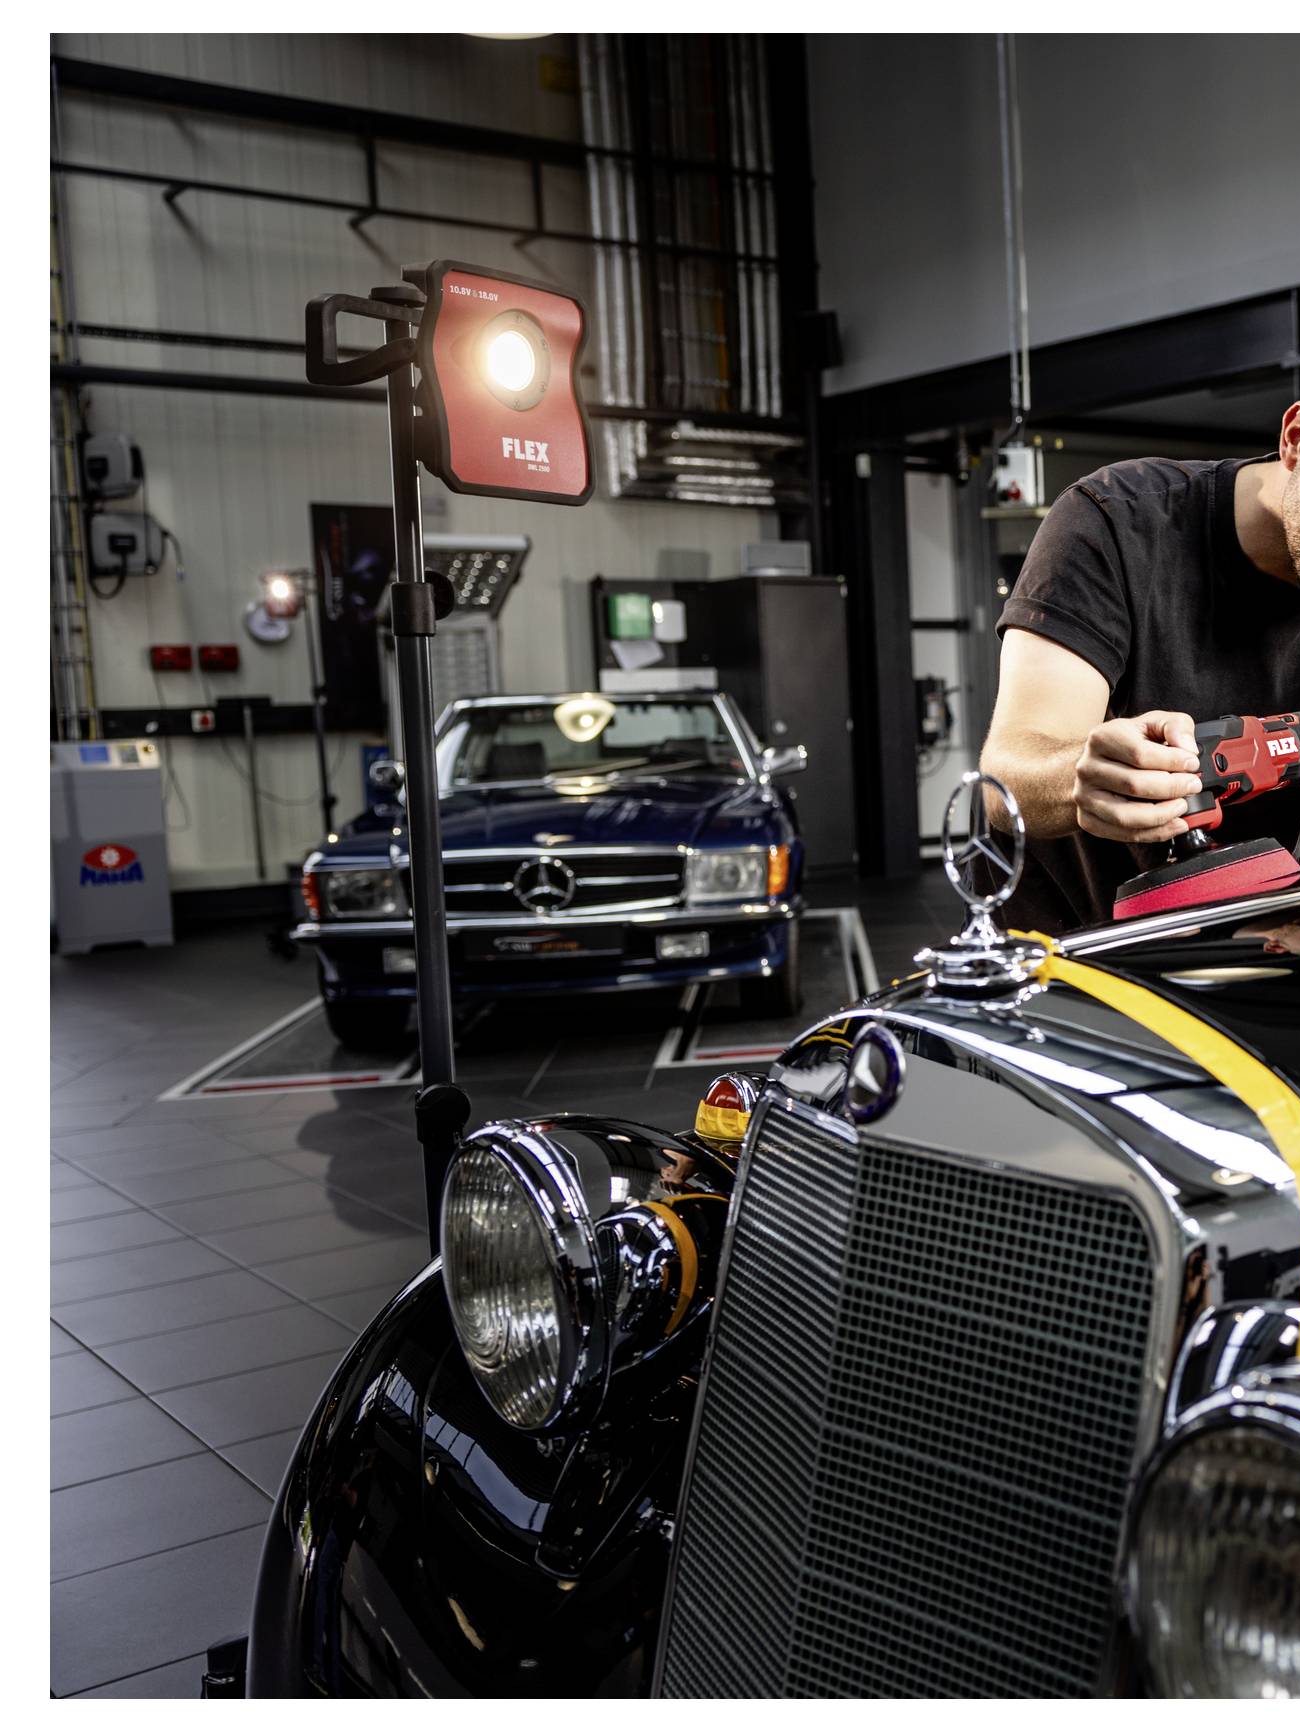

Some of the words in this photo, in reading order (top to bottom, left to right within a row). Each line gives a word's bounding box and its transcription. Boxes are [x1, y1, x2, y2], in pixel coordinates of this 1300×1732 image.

[449, 285, 471, 296] 10.8V
[478, 291, 499, 302] 18.0V
[502, 436, 550, 464] FLEX
[1266, 736, 1299, 757] FLEX
